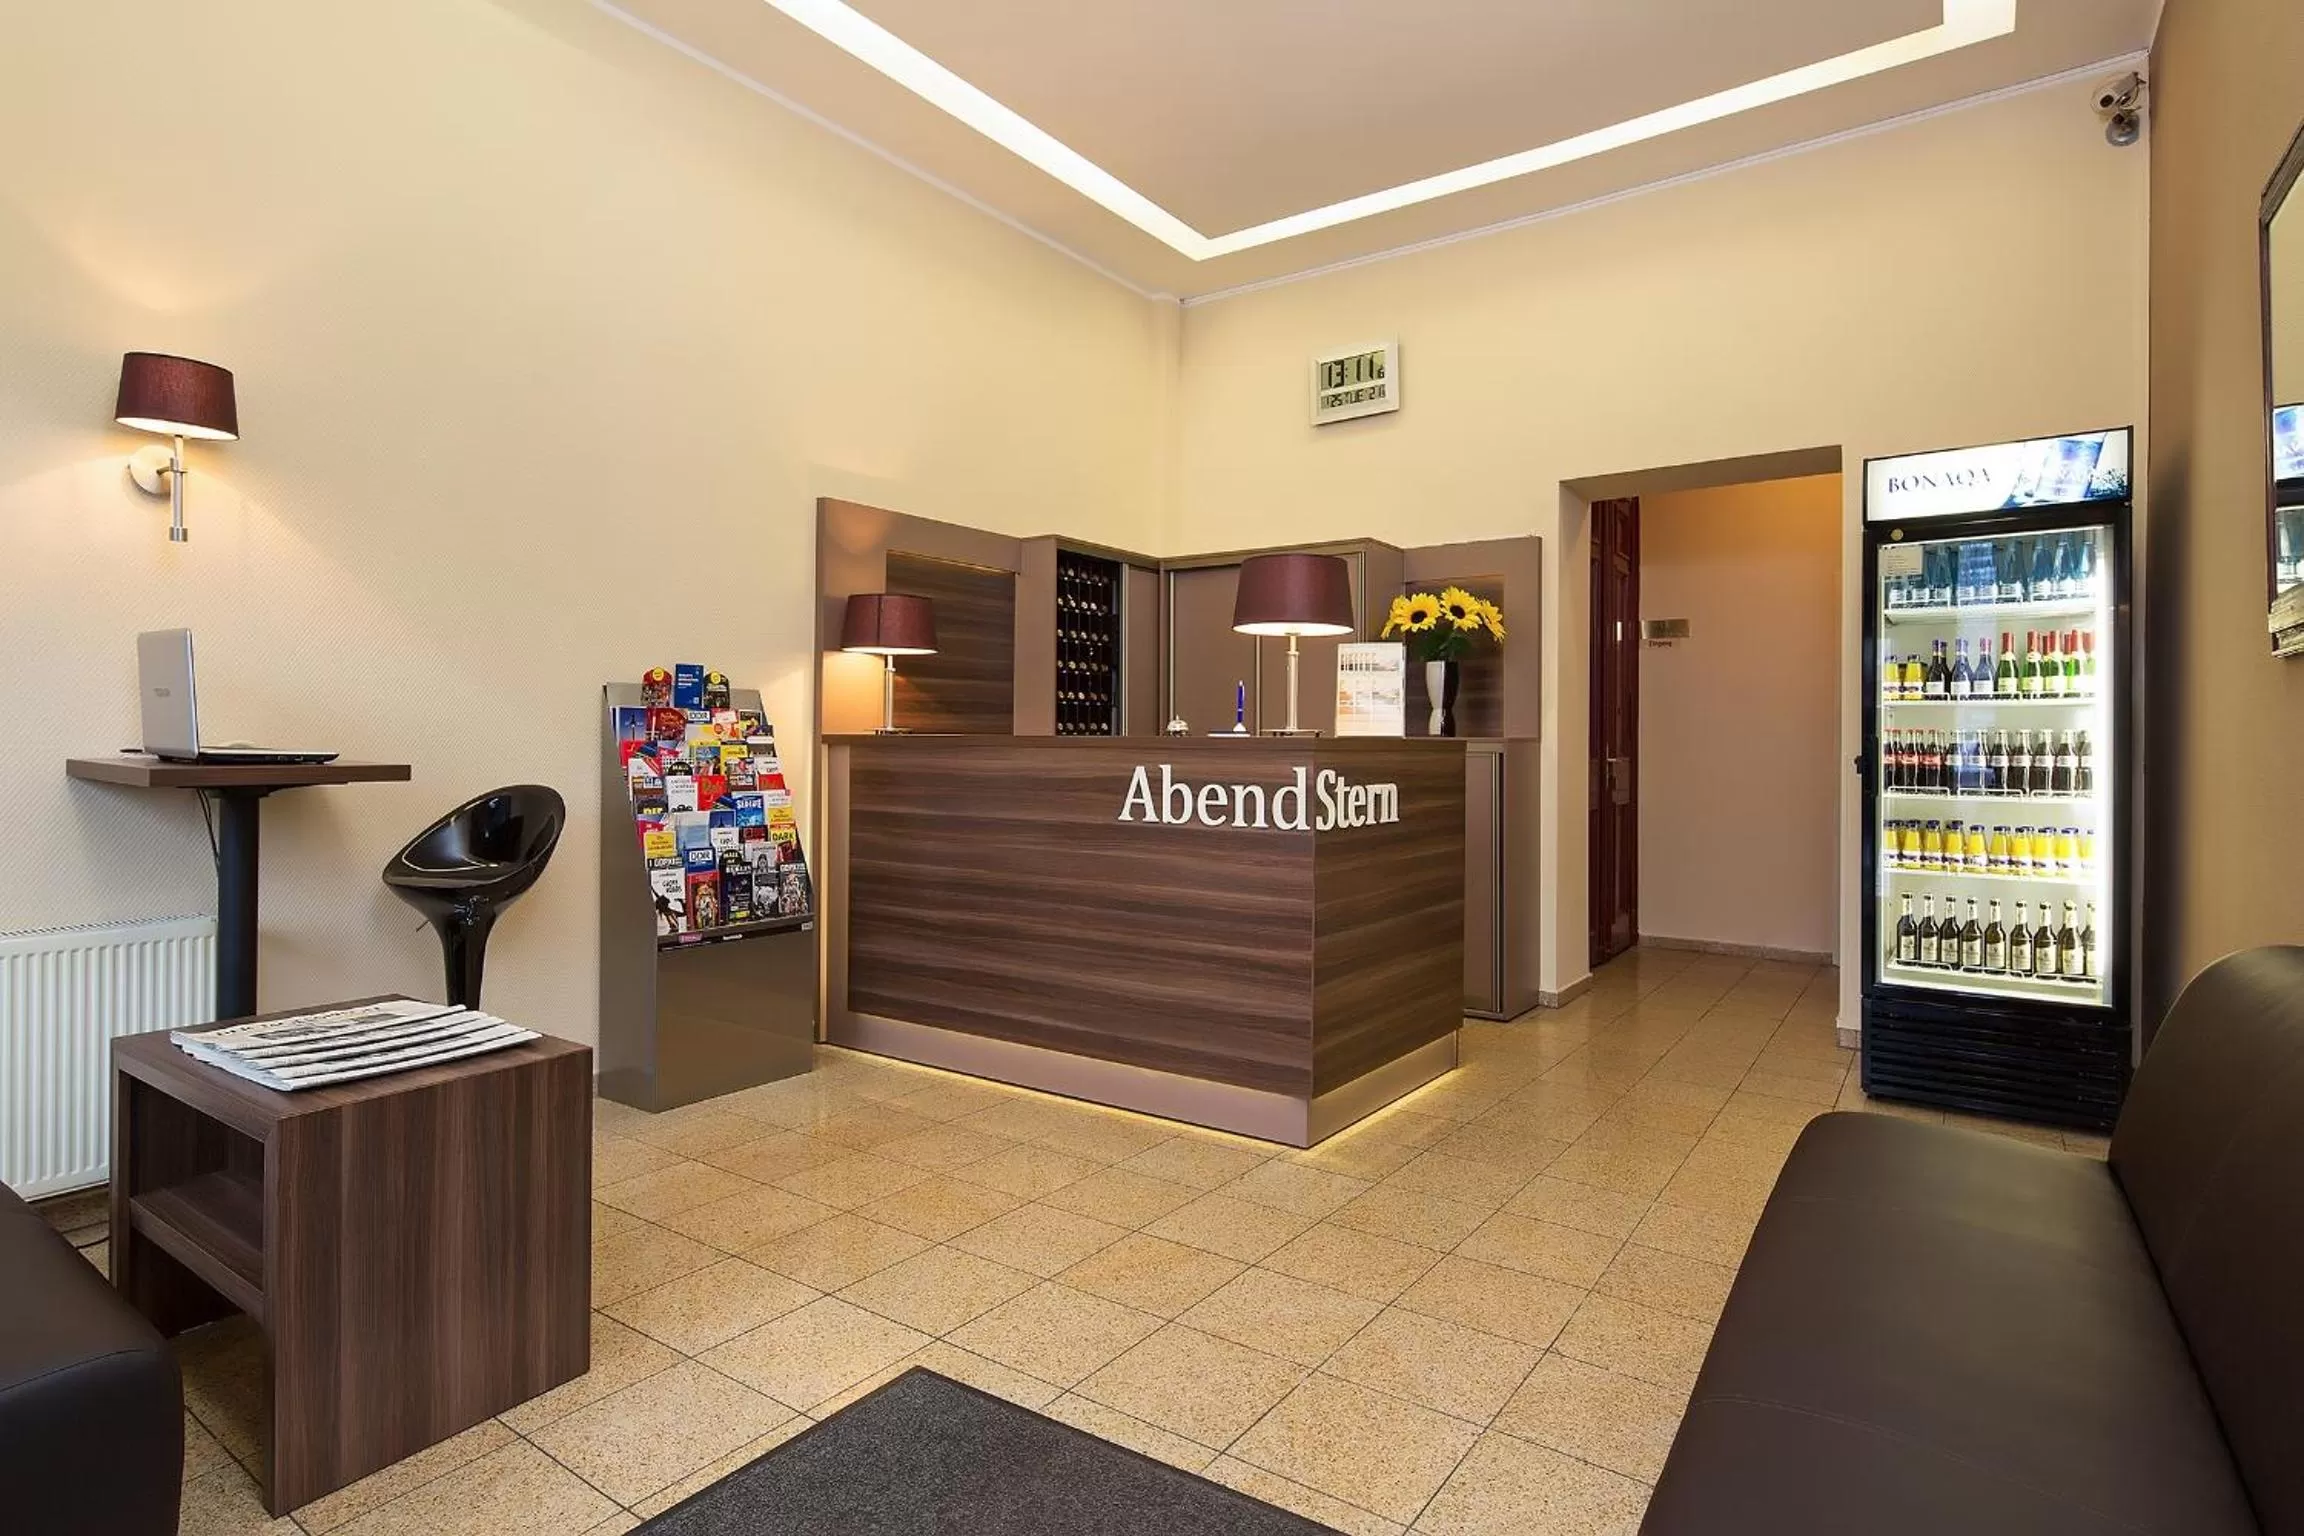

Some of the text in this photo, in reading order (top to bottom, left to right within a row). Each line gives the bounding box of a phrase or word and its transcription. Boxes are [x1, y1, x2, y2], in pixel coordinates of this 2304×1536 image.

[1328, 354, 1374, 388] 13:11
[1888, 467, 1991, 494] BONAQA
[1117, 763, 1400, 832] Abend Stern
